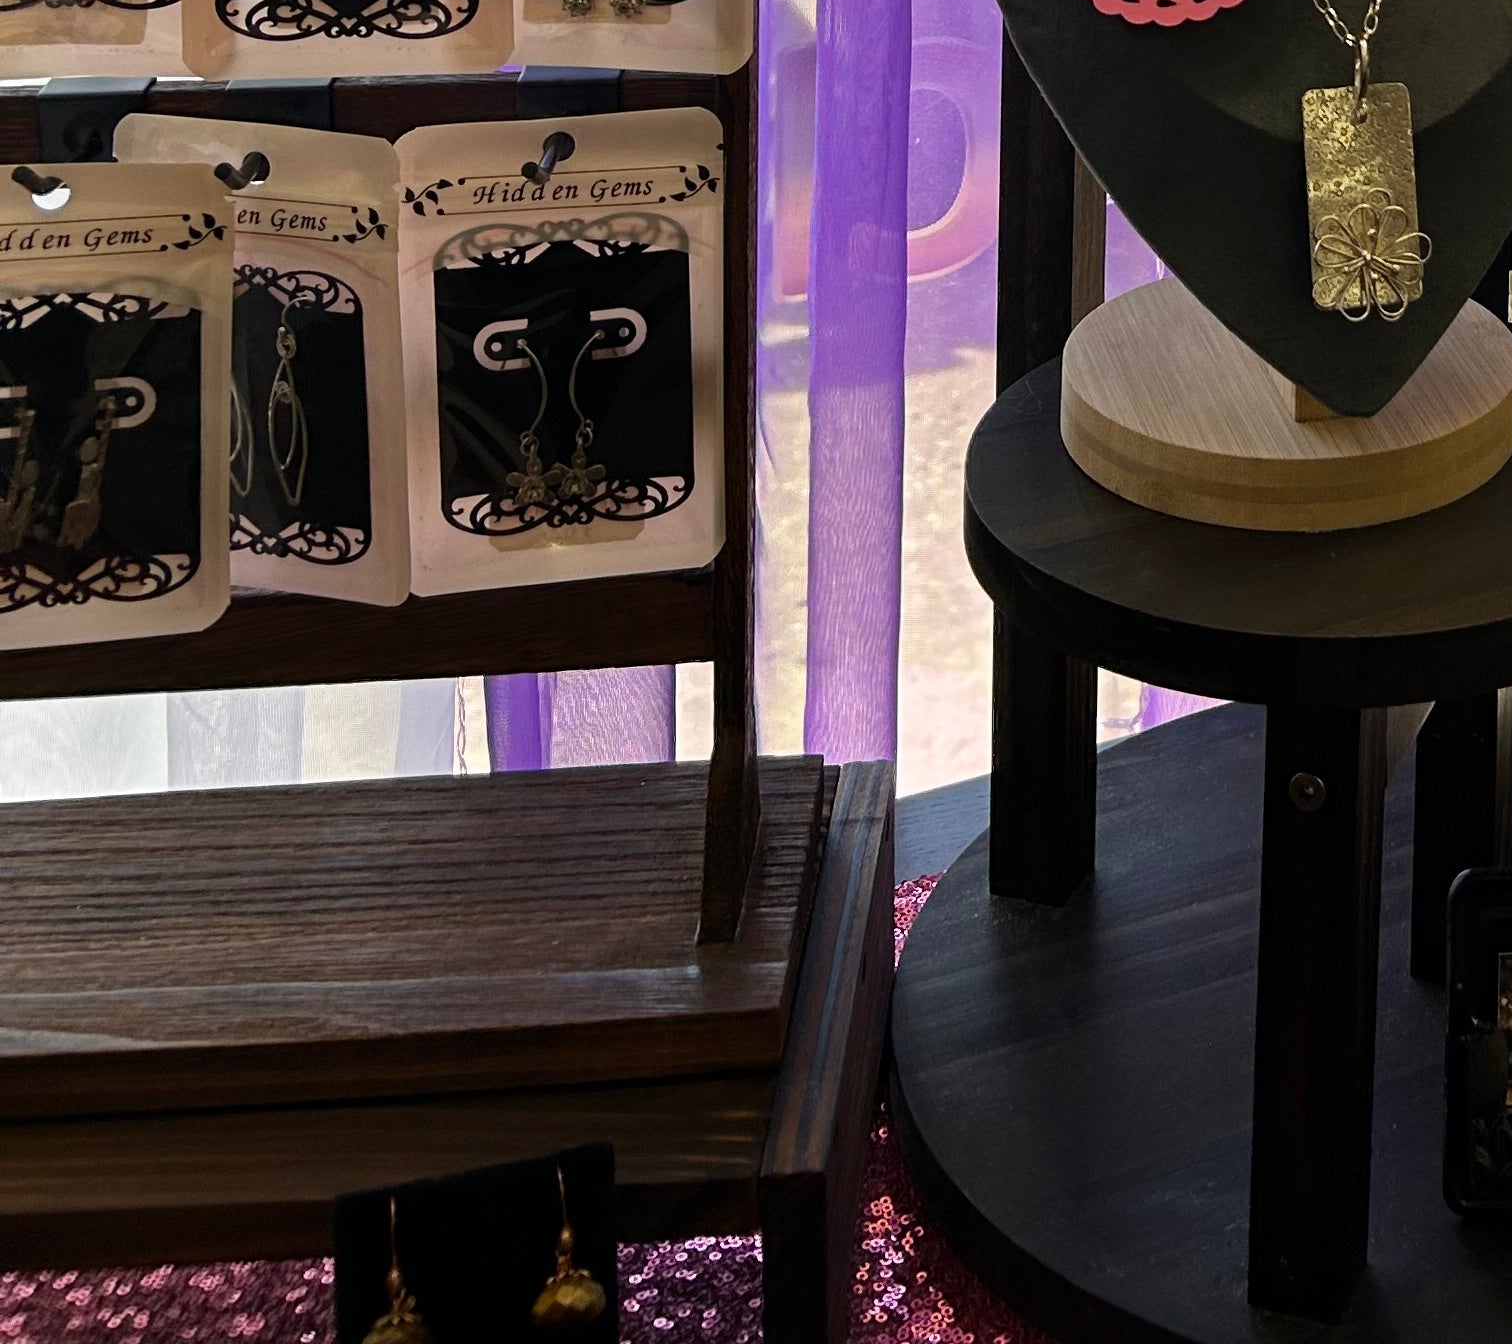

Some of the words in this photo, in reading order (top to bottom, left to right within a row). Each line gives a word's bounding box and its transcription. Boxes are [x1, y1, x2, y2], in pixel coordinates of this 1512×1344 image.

[472, 179, 579, 206] Hidden
[590, 179, 654, 200] Gems
[269, 208, 328, 232] Gems
[83, 228, 154, 252] Gems
